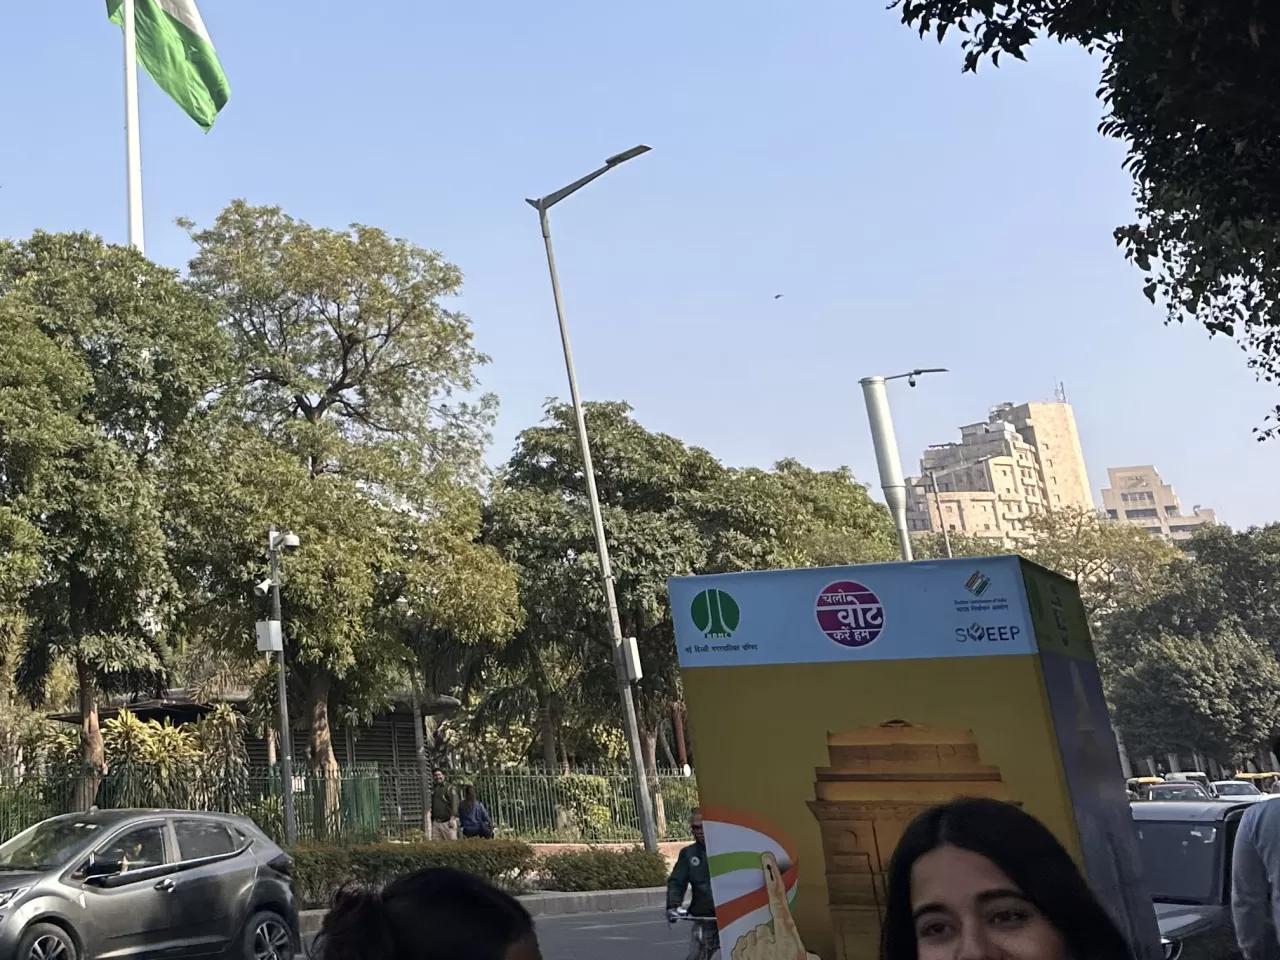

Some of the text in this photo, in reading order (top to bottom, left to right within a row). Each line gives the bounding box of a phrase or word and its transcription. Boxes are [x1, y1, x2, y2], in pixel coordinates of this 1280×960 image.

[821, 589, 847, 604] चलो
[836, 595, 883, 628] वोट
[832, 625, 871, 642] करें हम
[955, 625, 1020, 642] SWEEP
